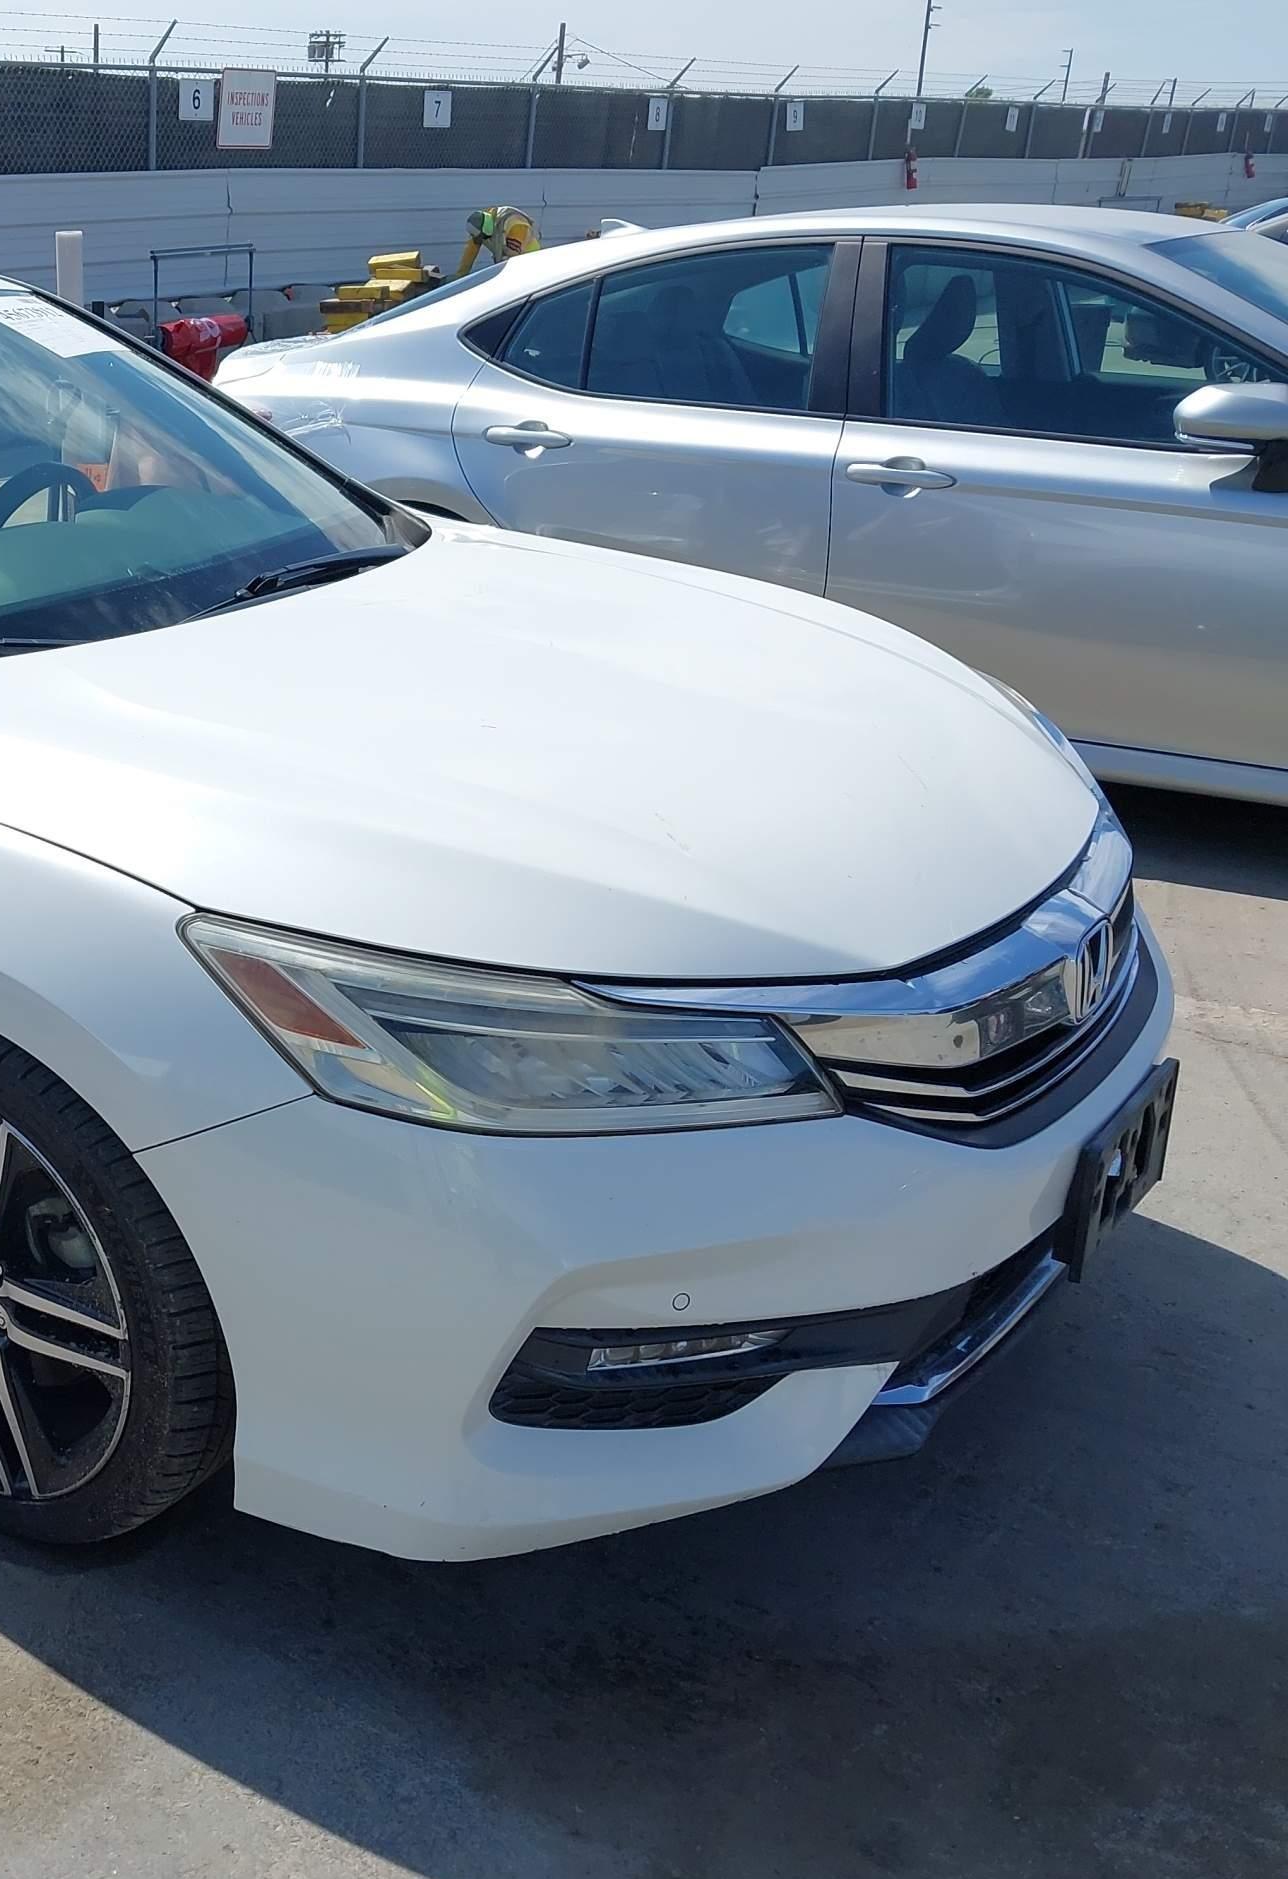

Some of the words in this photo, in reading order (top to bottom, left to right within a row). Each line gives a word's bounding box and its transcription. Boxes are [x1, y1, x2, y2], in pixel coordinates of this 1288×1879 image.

[192, 88, 201, 110] 6
[227, 90, 269, 107] INSPECTIONS
[434, 100, 441, 119] 7
[655, 106, 661, 122] 8
[793, 109, 798, 124] 9
[231, 111, 263, 127] VEHICLES
